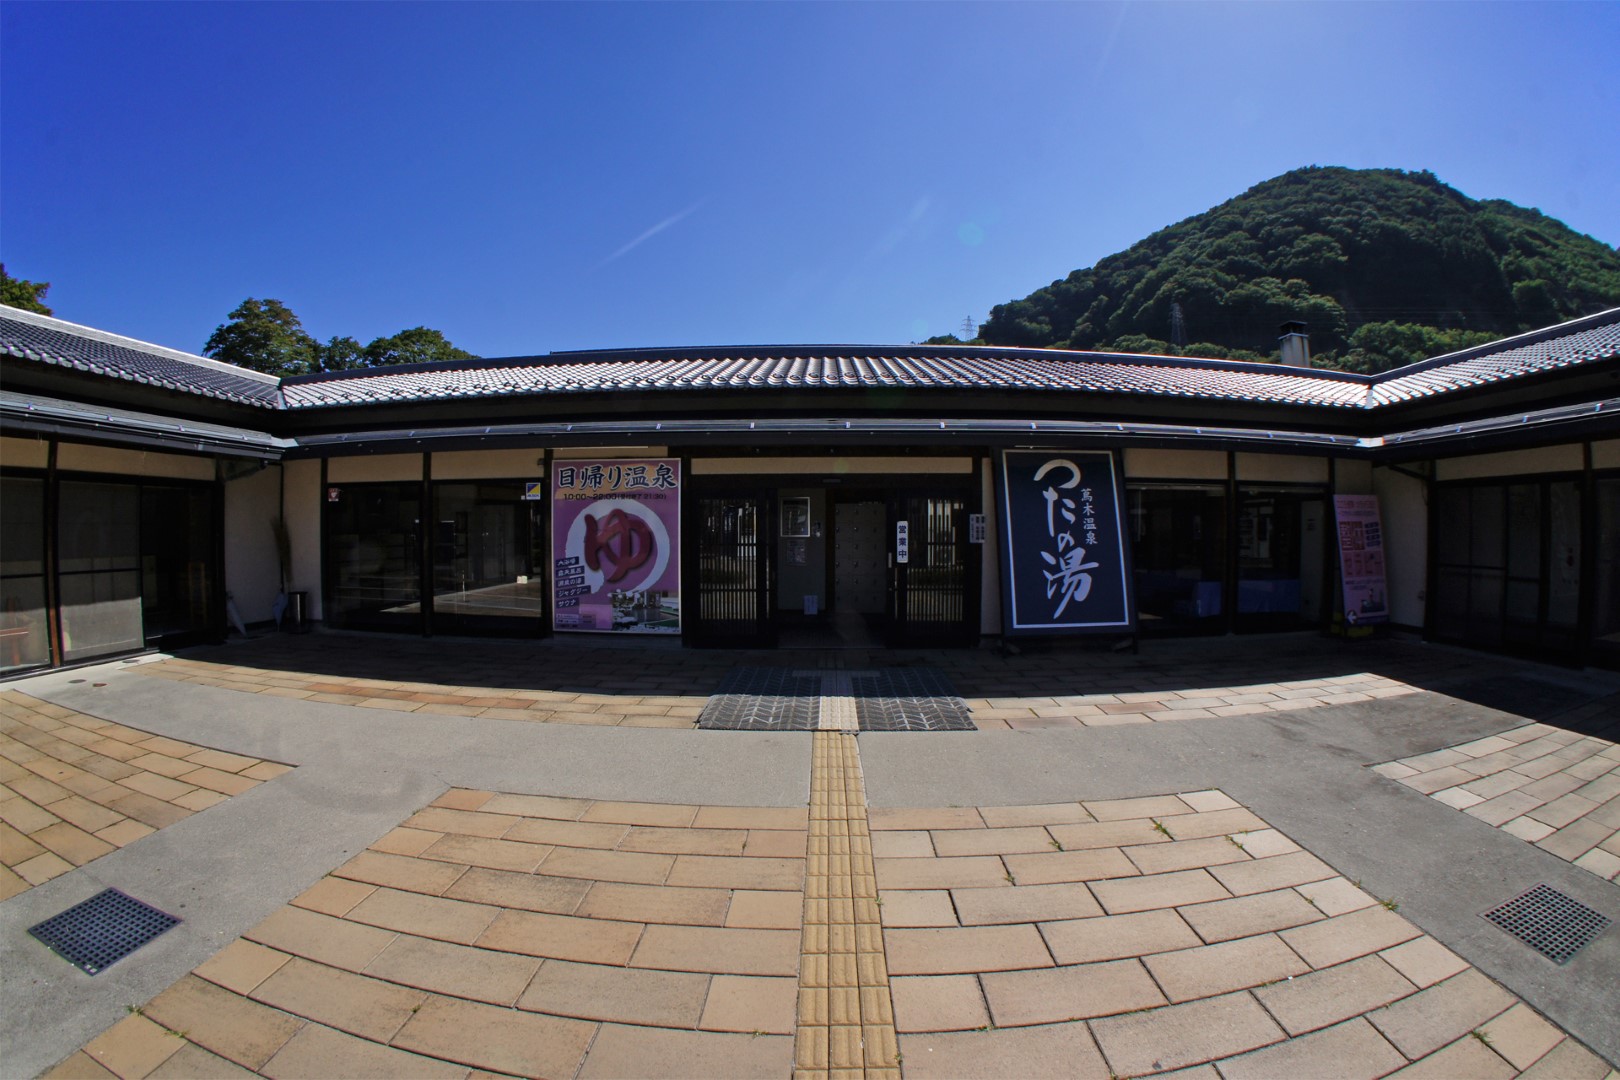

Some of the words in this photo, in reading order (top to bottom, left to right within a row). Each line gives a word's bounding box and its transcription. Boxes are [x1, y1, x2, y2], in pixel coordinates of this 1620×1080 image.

[559, 463, 678, 490] 日帰り温泉
[1081, 488, 1098, 545] 蔦木温泉
[584, 508, 653, 583] ゆ
[898, 525, 907, 559] 営業中
[1033, 458, 1099, 619] つたの湯
[558, 588, 588, 597] ジャグジー
[558, 599, 576, 607] サウナ
